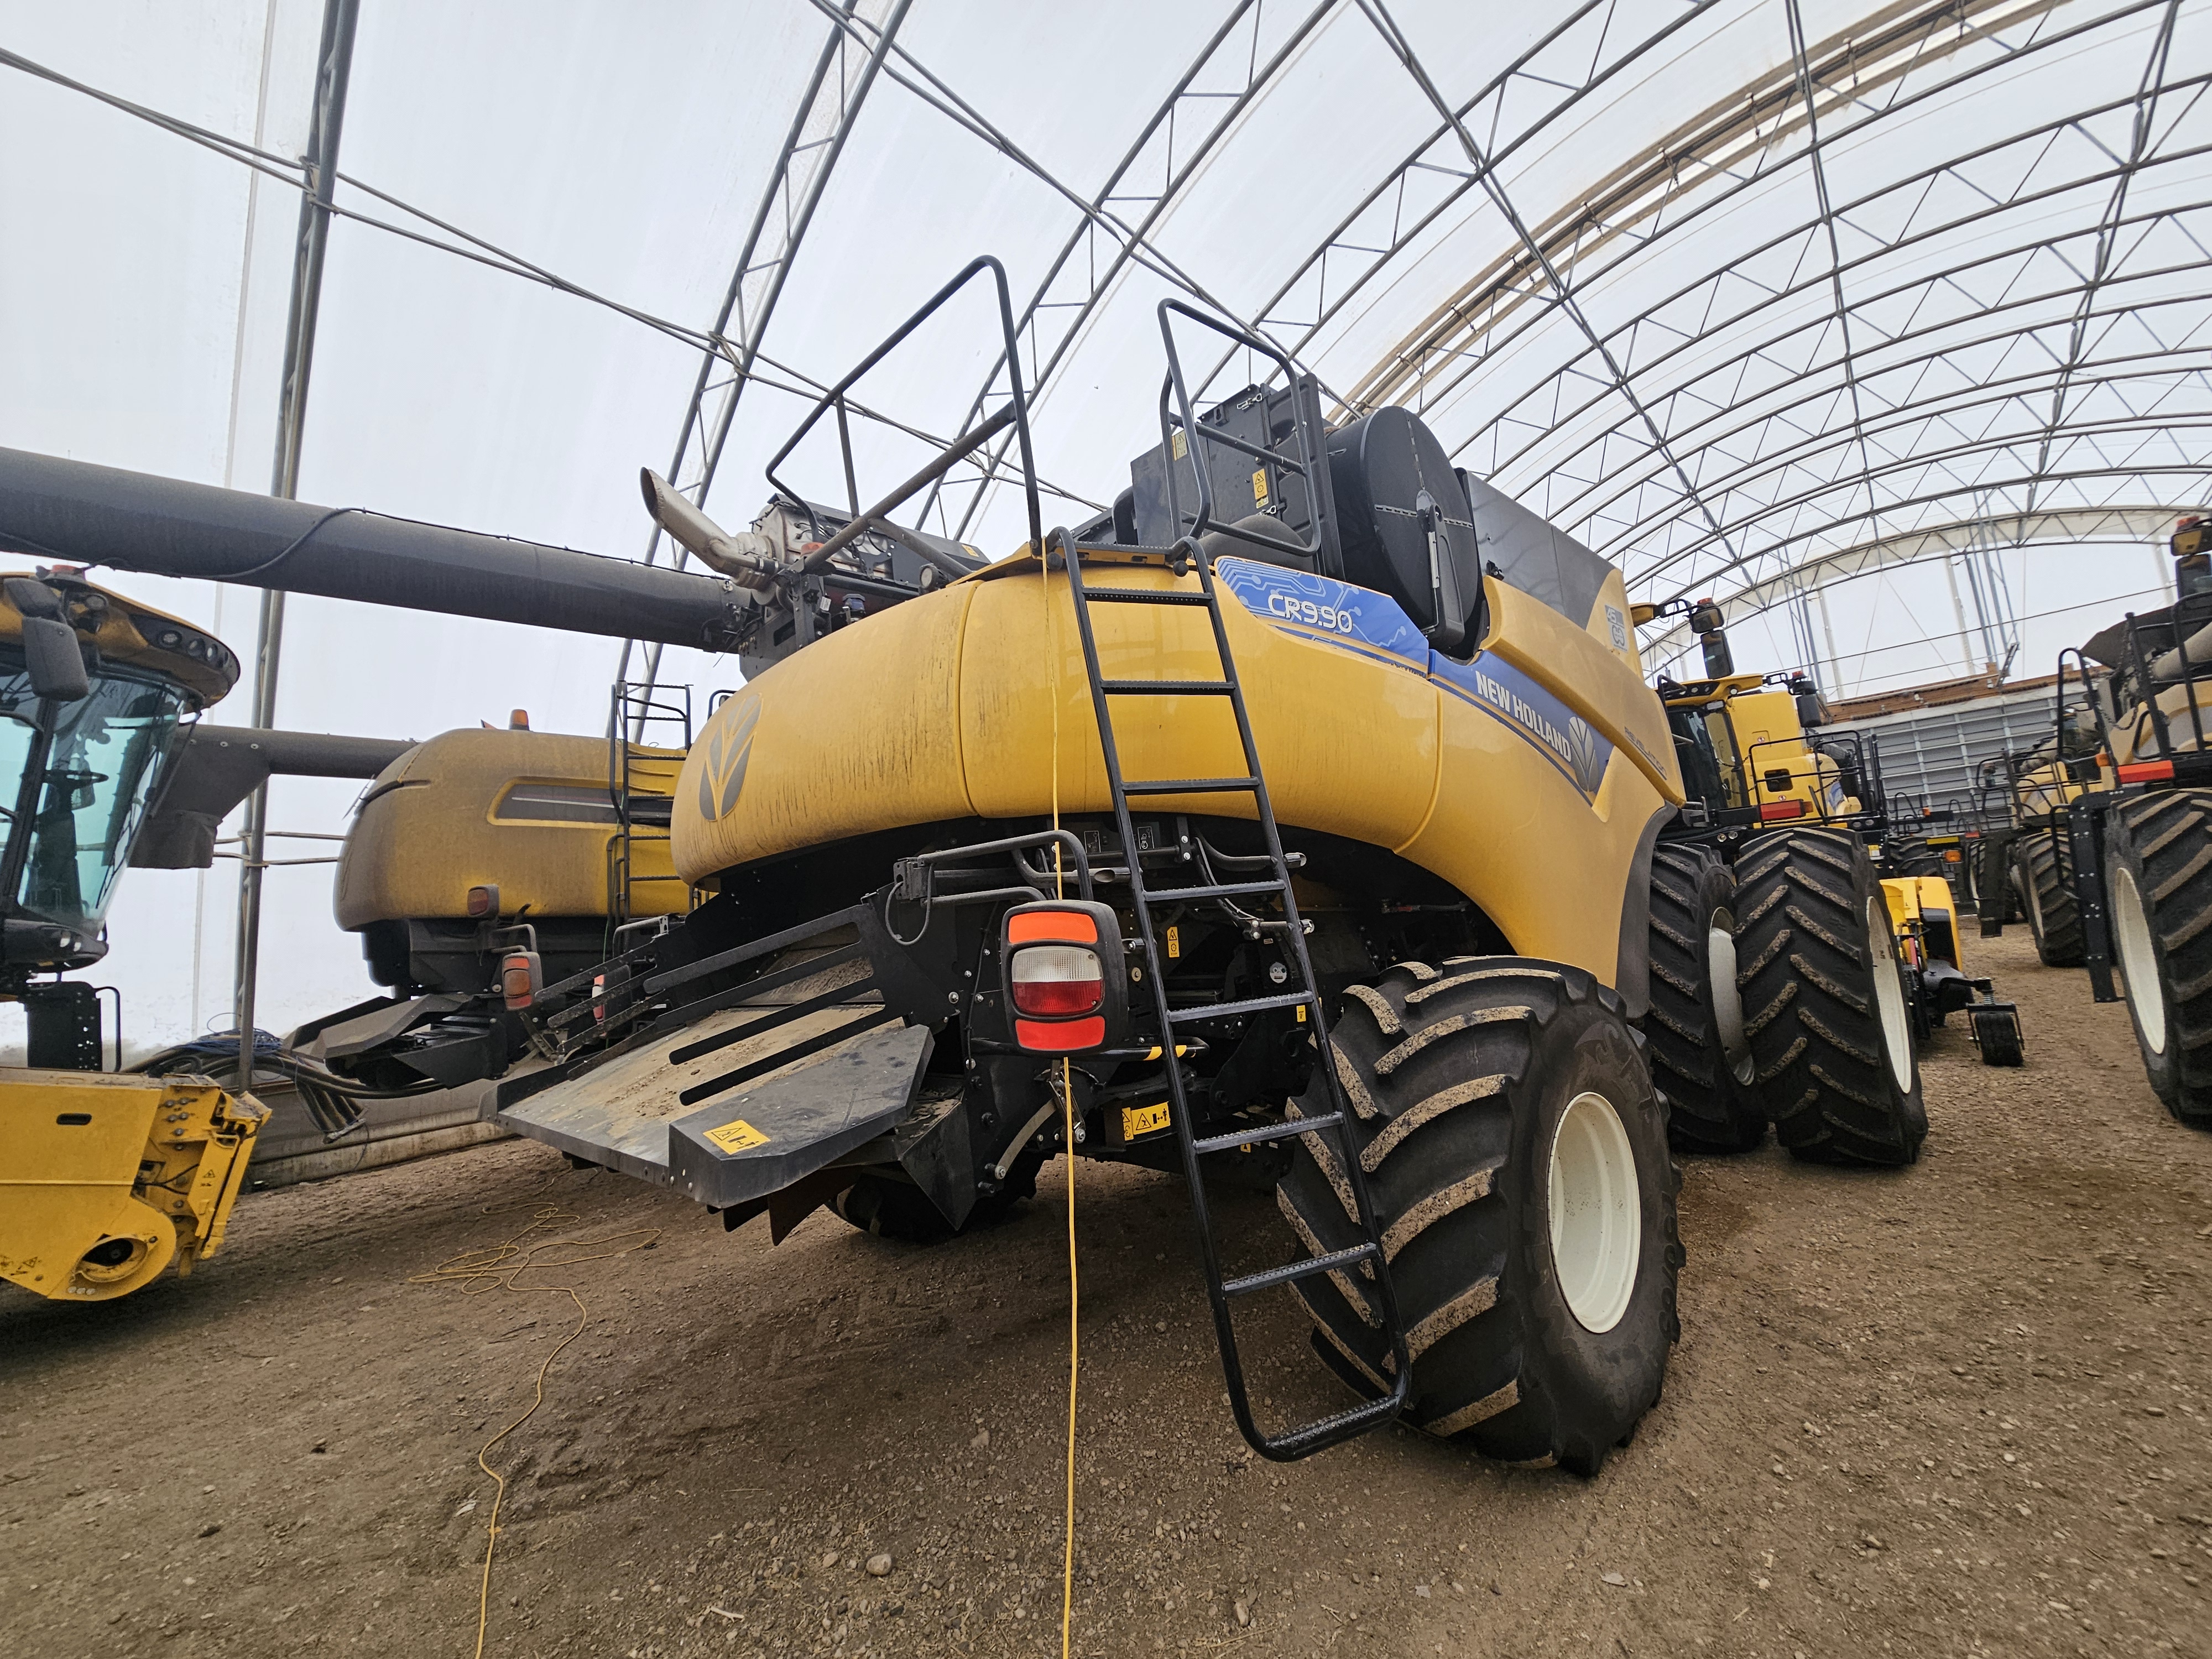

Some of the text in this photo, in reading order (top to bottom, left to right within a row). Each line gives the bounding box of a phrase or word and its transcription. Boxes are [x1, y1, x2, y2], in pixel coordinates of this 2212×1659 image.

[1268, 594, 1353, 633] CR9.90
[1475, 670, 1572, 762] NEW HOLLAND
